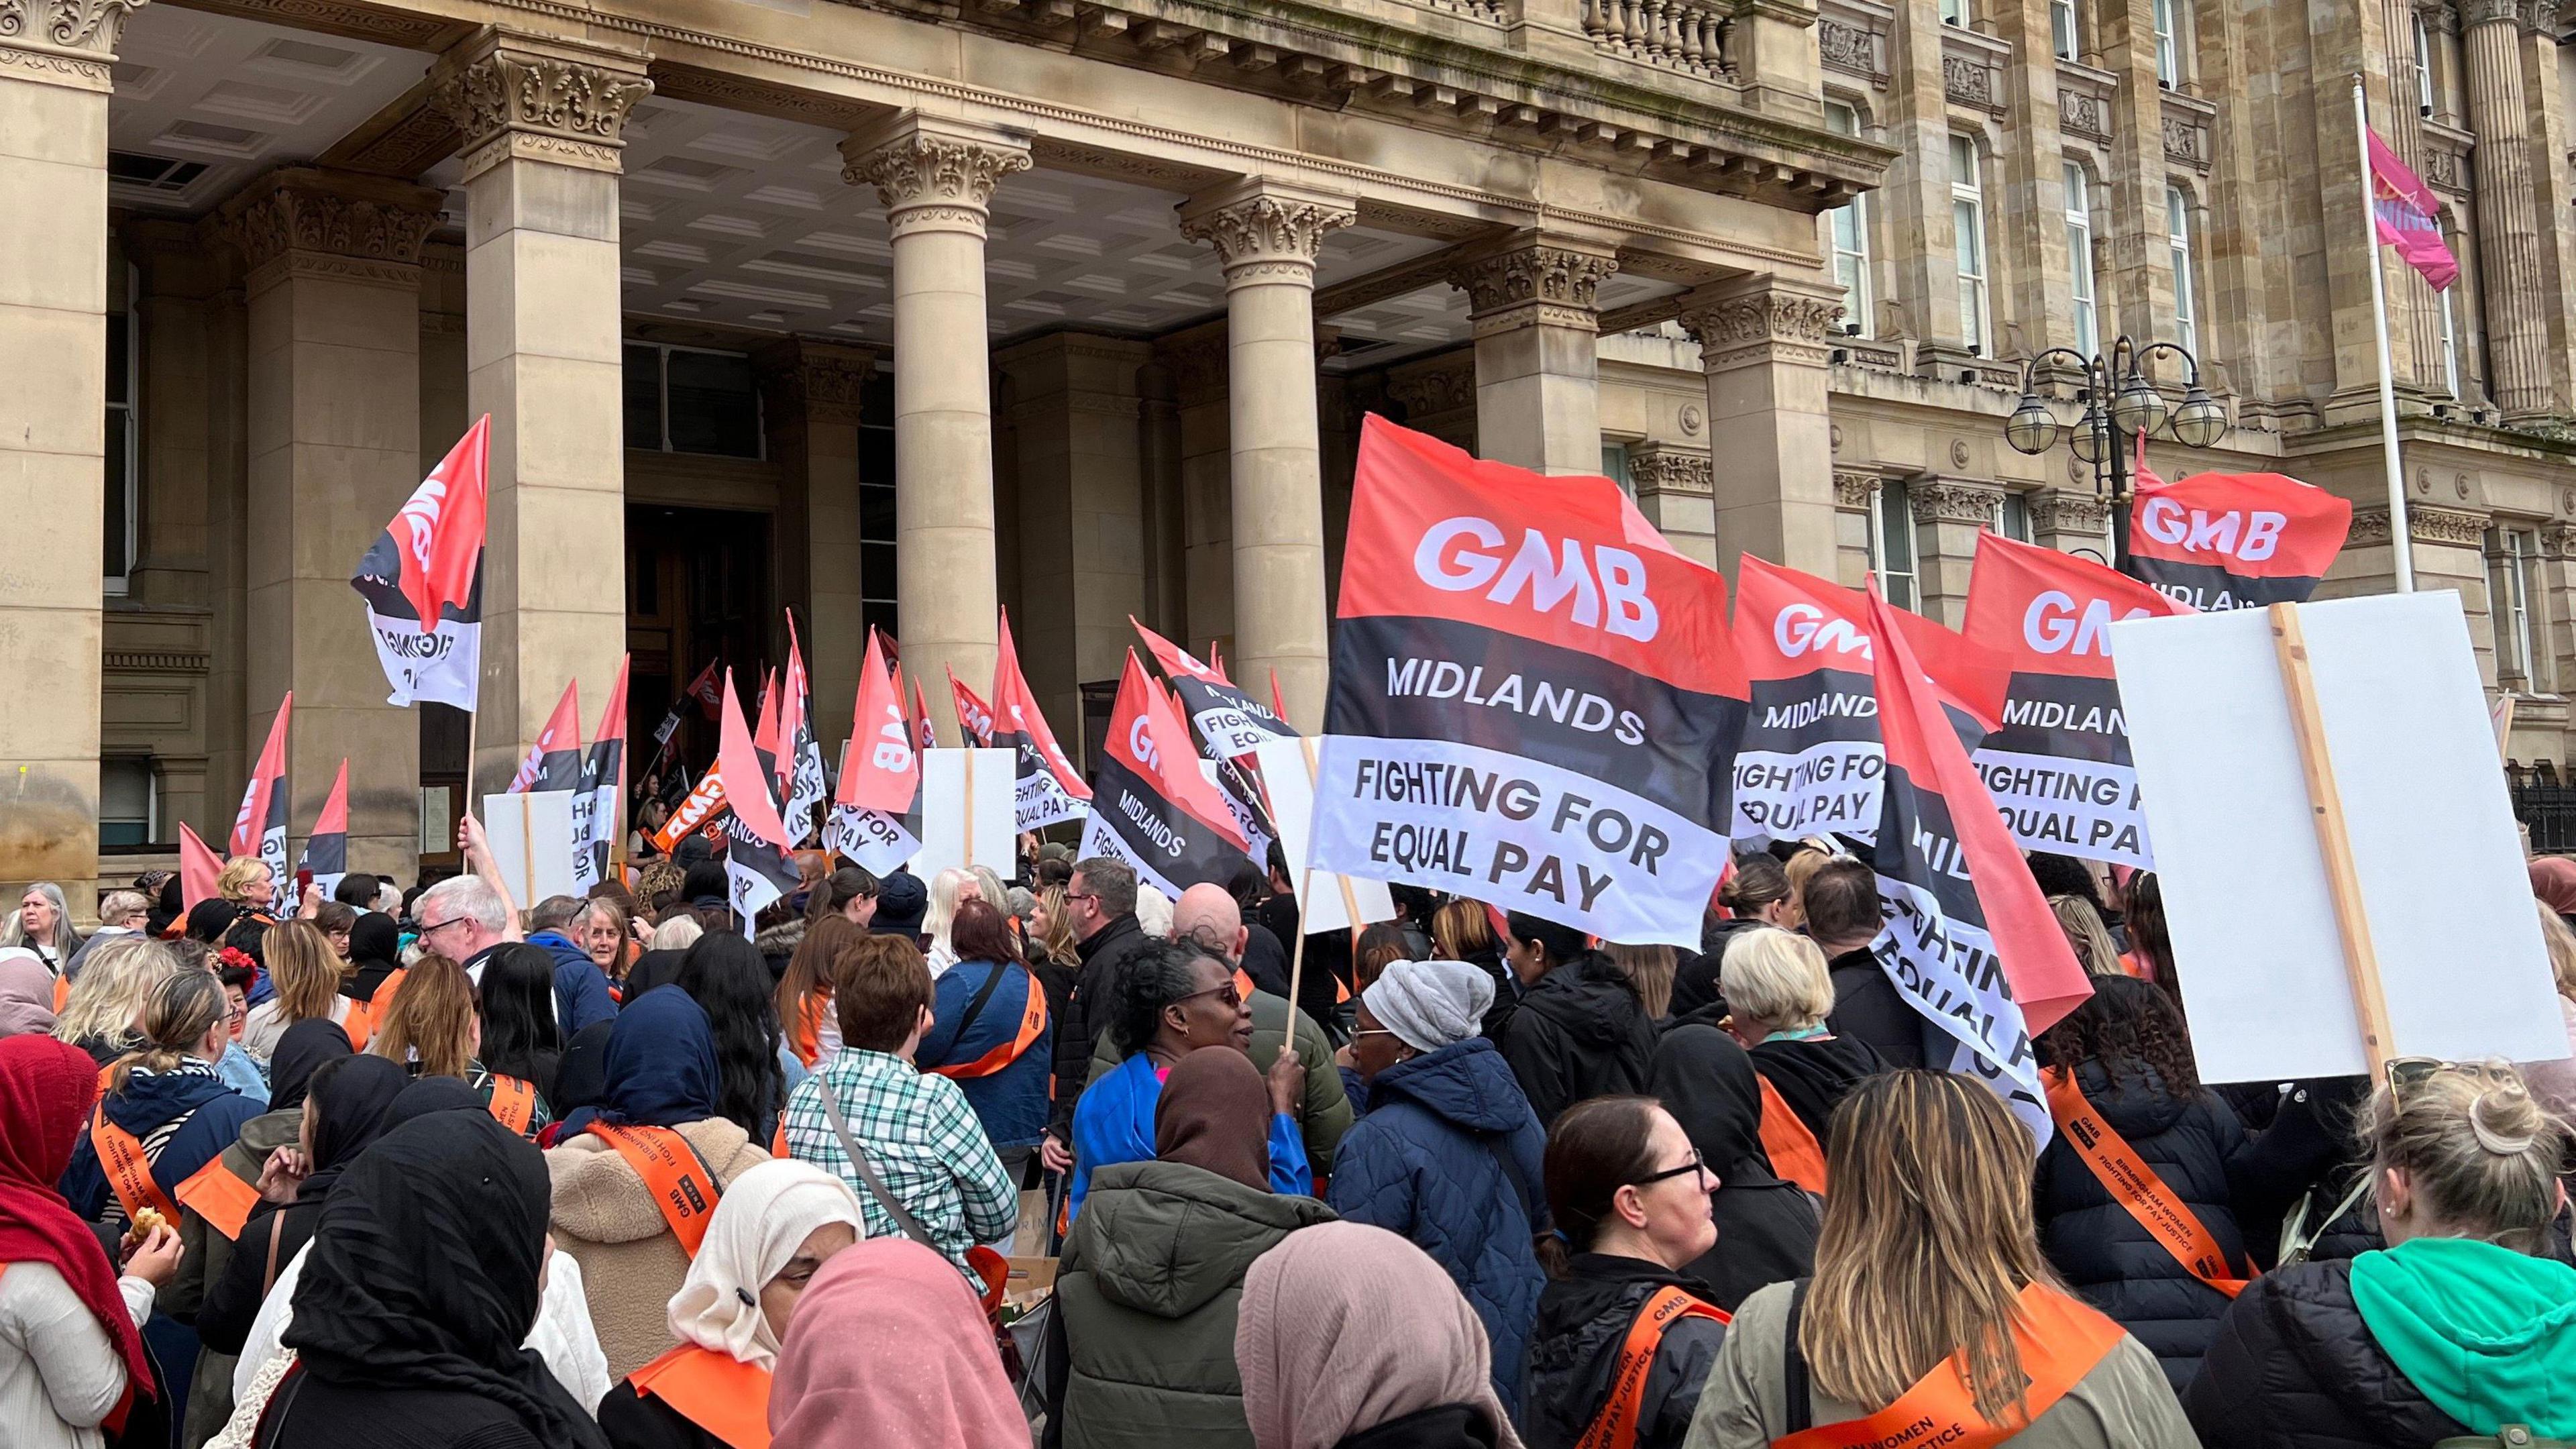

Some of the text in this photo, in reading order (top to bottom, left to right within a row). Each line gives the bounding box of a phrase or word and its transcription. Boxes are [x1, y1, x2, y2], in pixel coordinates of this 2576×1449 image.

[2142, 496, 2287, 561] GMB
[1414, 516, 1659, 643] GMB
[1387, 657, 1646, 746] MIDLANDS
[1733, 754, 1886, 793] IGHTING FO
[1973, 763, 2119, 807] IGHTING
[857, 810, 899, 847] FOR
[1118, 790, 1187, 857] MIDLANDS
[1354, 759, 1670, 875] FIGHTING FOR
[1811, 792, 1871, 822] PAY
[2088, 818, 2141, 855] PA
[1371, 822, 1614, 913] EQUAL PAY
[2081, 1117, 2101, 1139] GMB
[669, 1188, 690, 1218] GMB
[2098, 1155, 2194, 1253] FIGHTING FOR PAY JUSTICE
[2115, 1157, 2194, 1238] BIRMINGHAM WOMEN
[1654, 1295, 1688, 1321] GMB
[1620, 1346, 1654, 1401] JUSTICE
[1916, 1422, 1966, 1449] STICE
